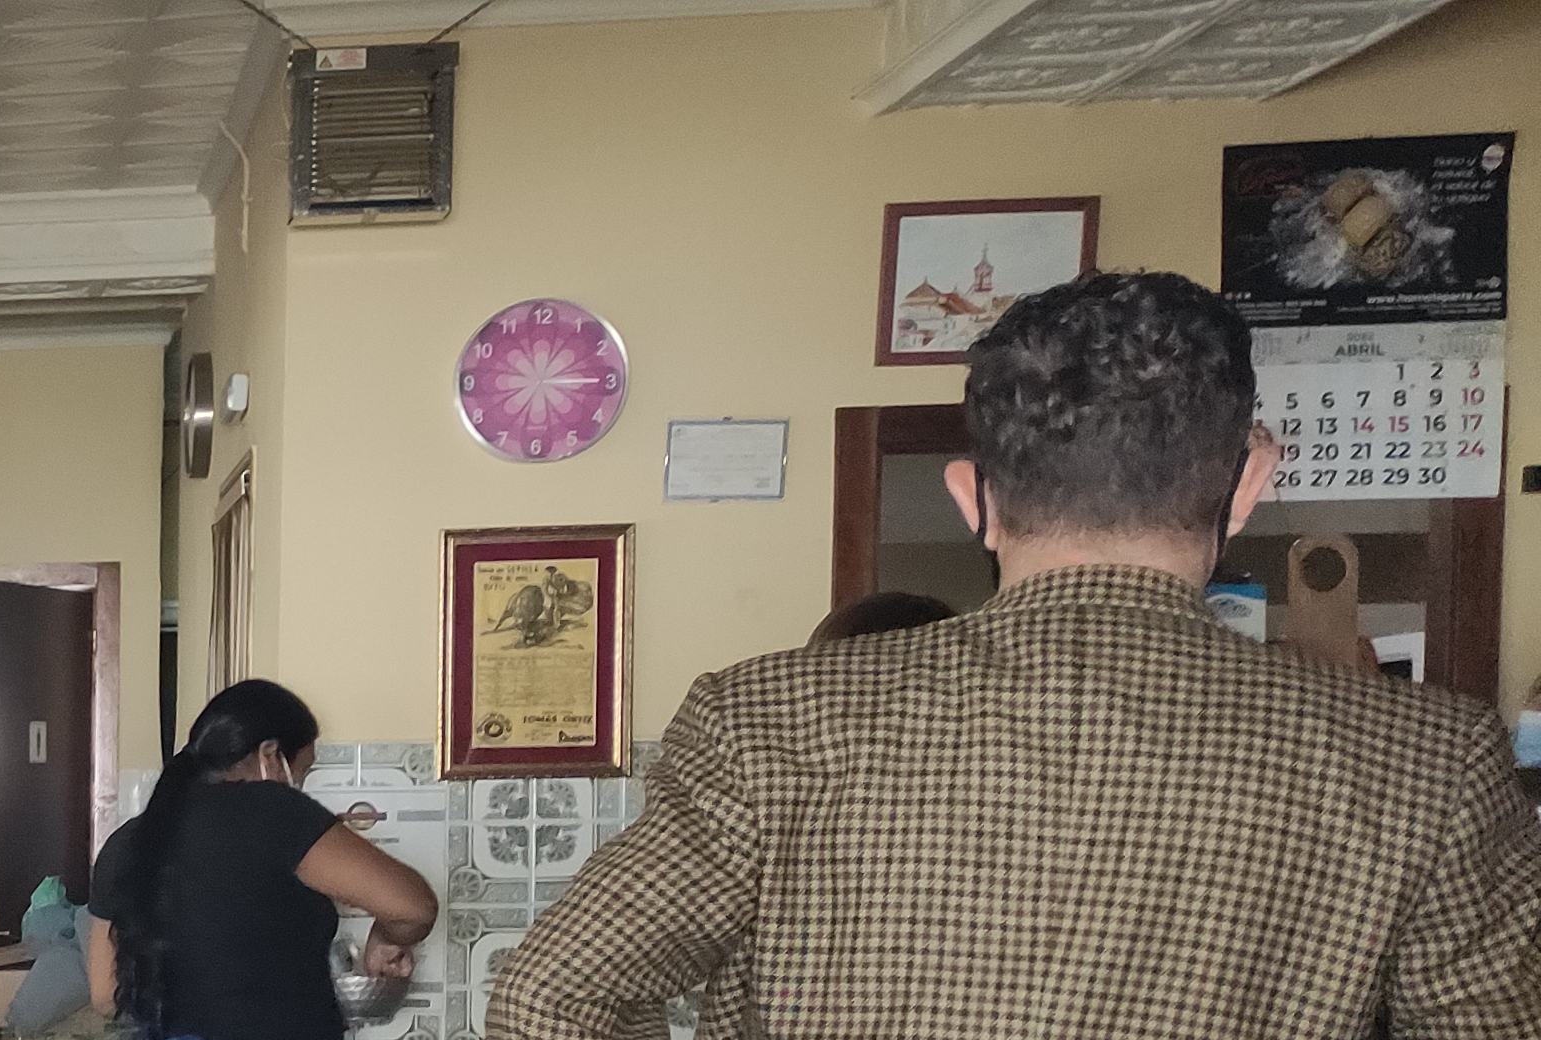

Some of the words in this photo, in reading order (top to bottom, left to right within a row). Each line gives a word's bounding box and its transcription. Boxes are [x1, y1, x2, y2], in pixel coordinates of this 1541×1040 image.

[534, 308, 553, 324] 12
[500, 319, 517, 334] 11
[575, 318, 583, 333] 1
[473, 342, 493, 358] 10
[596, 339, 608, 356] 2
[1335, 343, 1386, 356] ABRIL
[1397, 363, 1404, 380] 1
[1430, 362, 1443, 380] 2
[1469, 360, 1480, 380] 3
[463, 375, 475, 391] 9
[605, 373, 616, 390] 3
[1286, 392, 1298, 410] 5
[1321, 391, 1335, 409] 6
[1356, 390, 1371, 408] 7
[1393, 390, 1406, 406] 8
[1429, 388, 1443, 407] 9
[1461, 387, 1485, 406] 10
[472, 408, 484, 424] 8
[591, 407, 603, 423] 4
[1280, 418, 1302, 436] 12
[1316, 417, 1338, 434] 13
[1350, 416, 1375, 433] 14
[1388, 416, 1409, 433] 15
[1422, 414, 1447, 433] 16
[1461, 414, 1484, 432] 17
[497, 431, 508, 446] 7
[567, 430, 577, 446] 5
[530, 438, 542, 455] 6
[1280, 443, 1301, 461] 19
[1311, 443, 1339, 460] 20
[1349, 443, 1372, 460] 21
[1384, 441, 1411, 458] 22
[1421, 440, 1448, 458] 23
[1457, 439, 1485, 457] 24
[1273, 470, 1301, 488] 26
[1310, 469, 1338, 488] 27
[1344, 468, 1374, 487] 28
[1382, 467, 1409, 485] 29
[1418, 466, 1447, 484] 30
